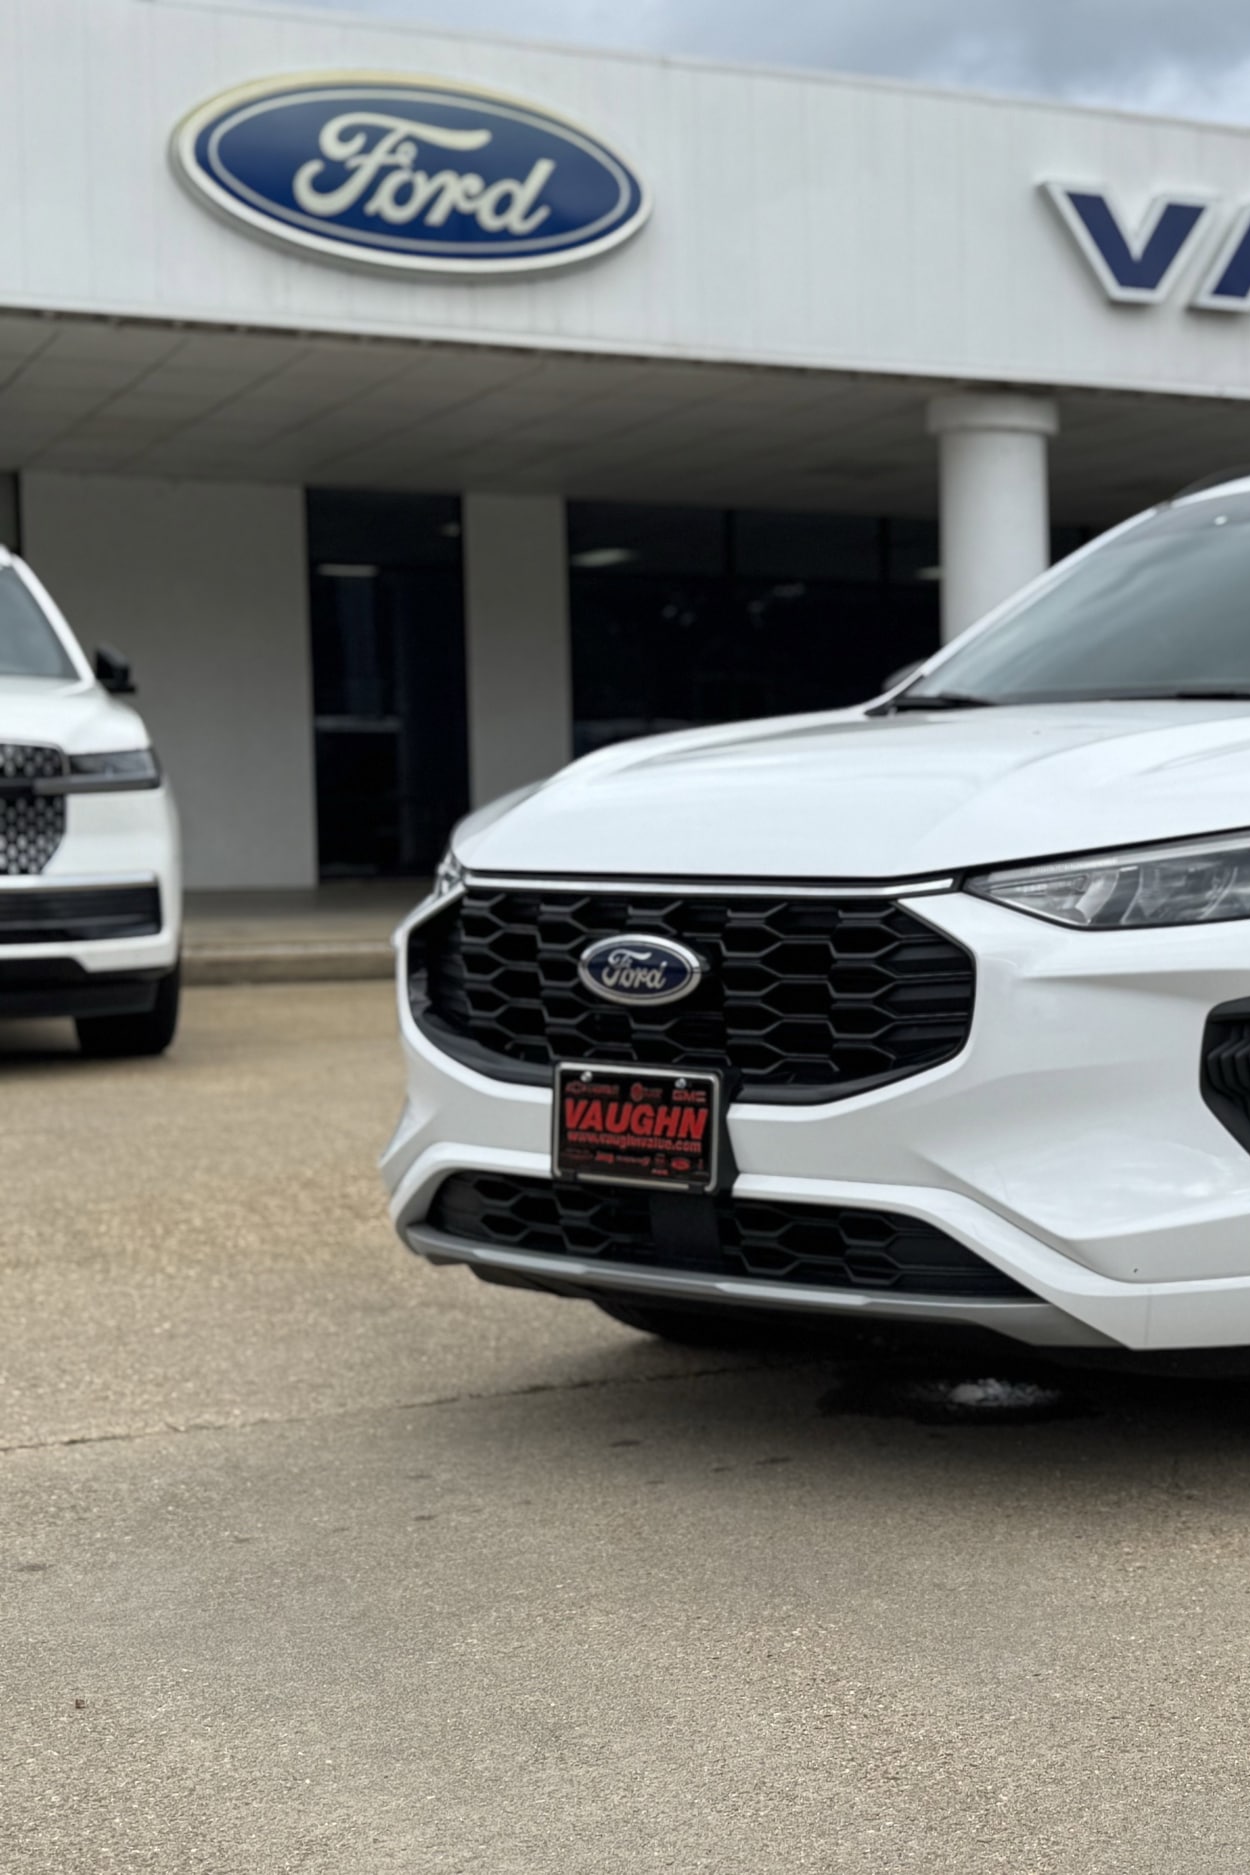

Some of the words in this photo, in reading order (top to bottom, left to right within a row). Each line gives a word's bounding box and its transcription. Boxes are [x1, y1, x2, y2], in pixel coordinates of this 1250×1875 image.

[292, 111, 557, 236] Ford
[601, 948, 668, 989] Ford
[565, 1097, 709, 1140] VAUGHN
